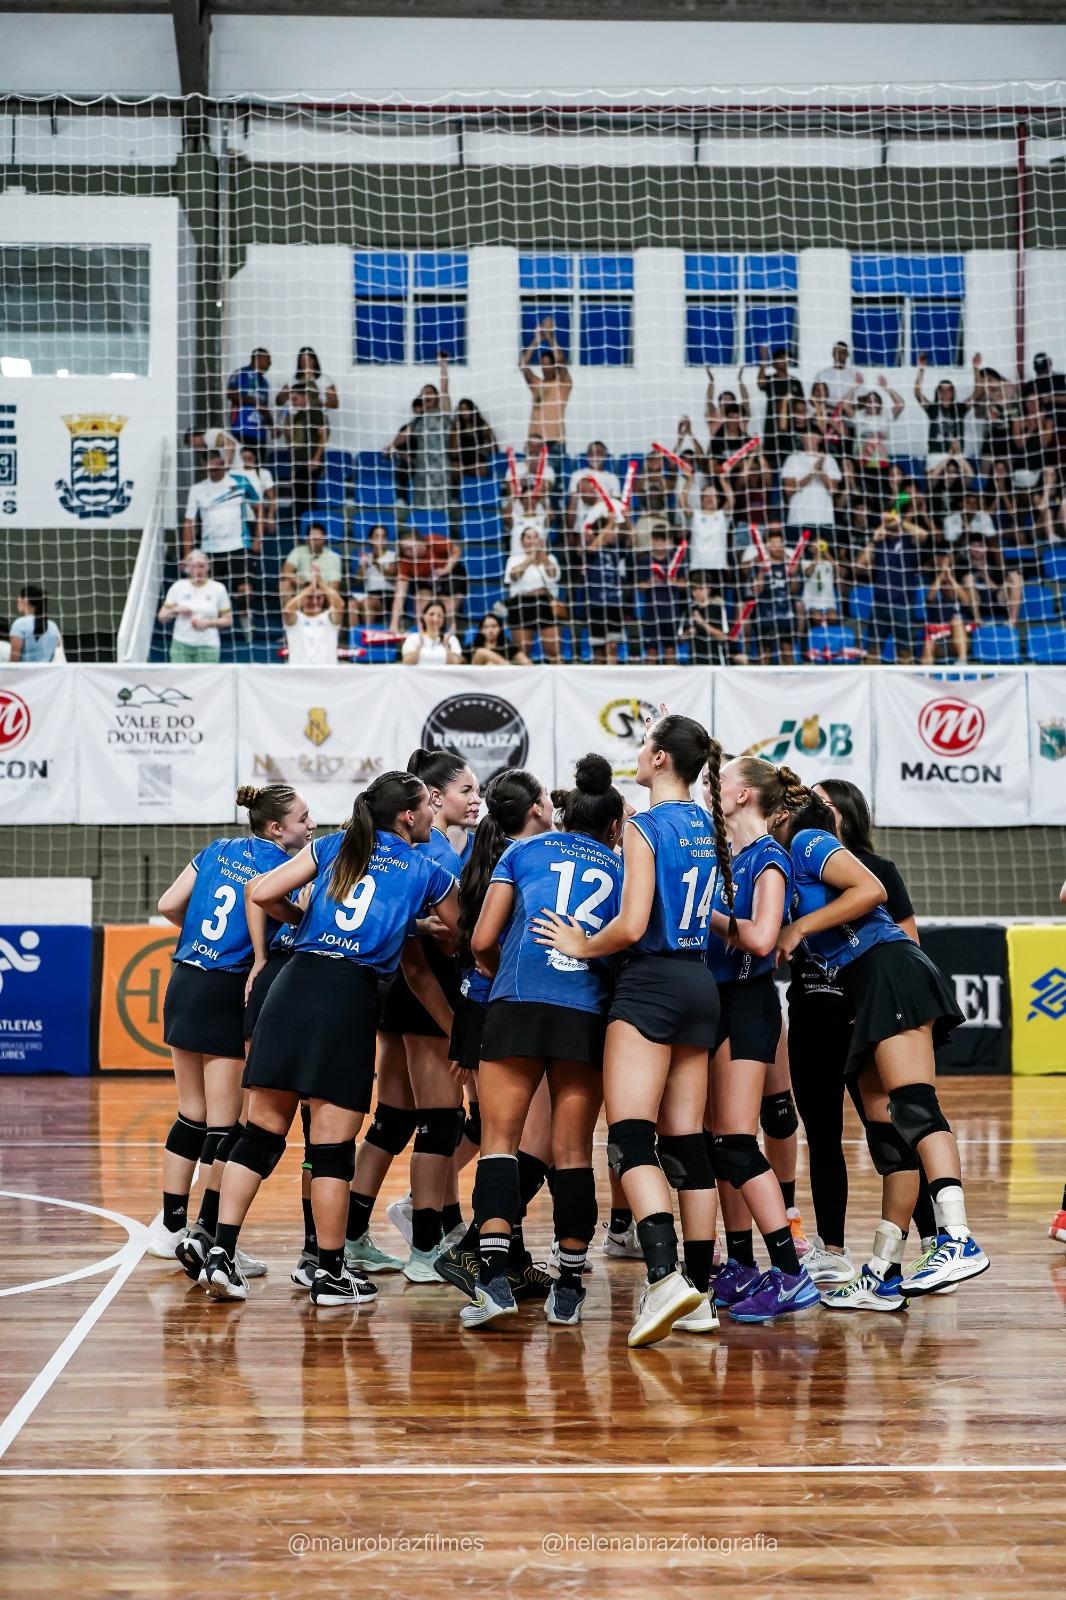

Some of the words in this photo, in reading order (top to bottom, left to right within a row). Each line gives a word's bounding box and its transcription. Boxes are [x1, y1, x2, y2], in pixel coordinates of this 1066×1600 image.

[107, 729, 204, 745] DOURADO
[115, 714, 161, 729] VALE
[166, 714, 195, 729] DO
[900, 761, 1003, 784] MACON
[201, 884, 237, 941] 3
[334, 874, 376, 932] 9
[549, 860, 614, 930] 12
[678, 866, 719, 930] 14
[318, 932, 360, 953] JOANA
